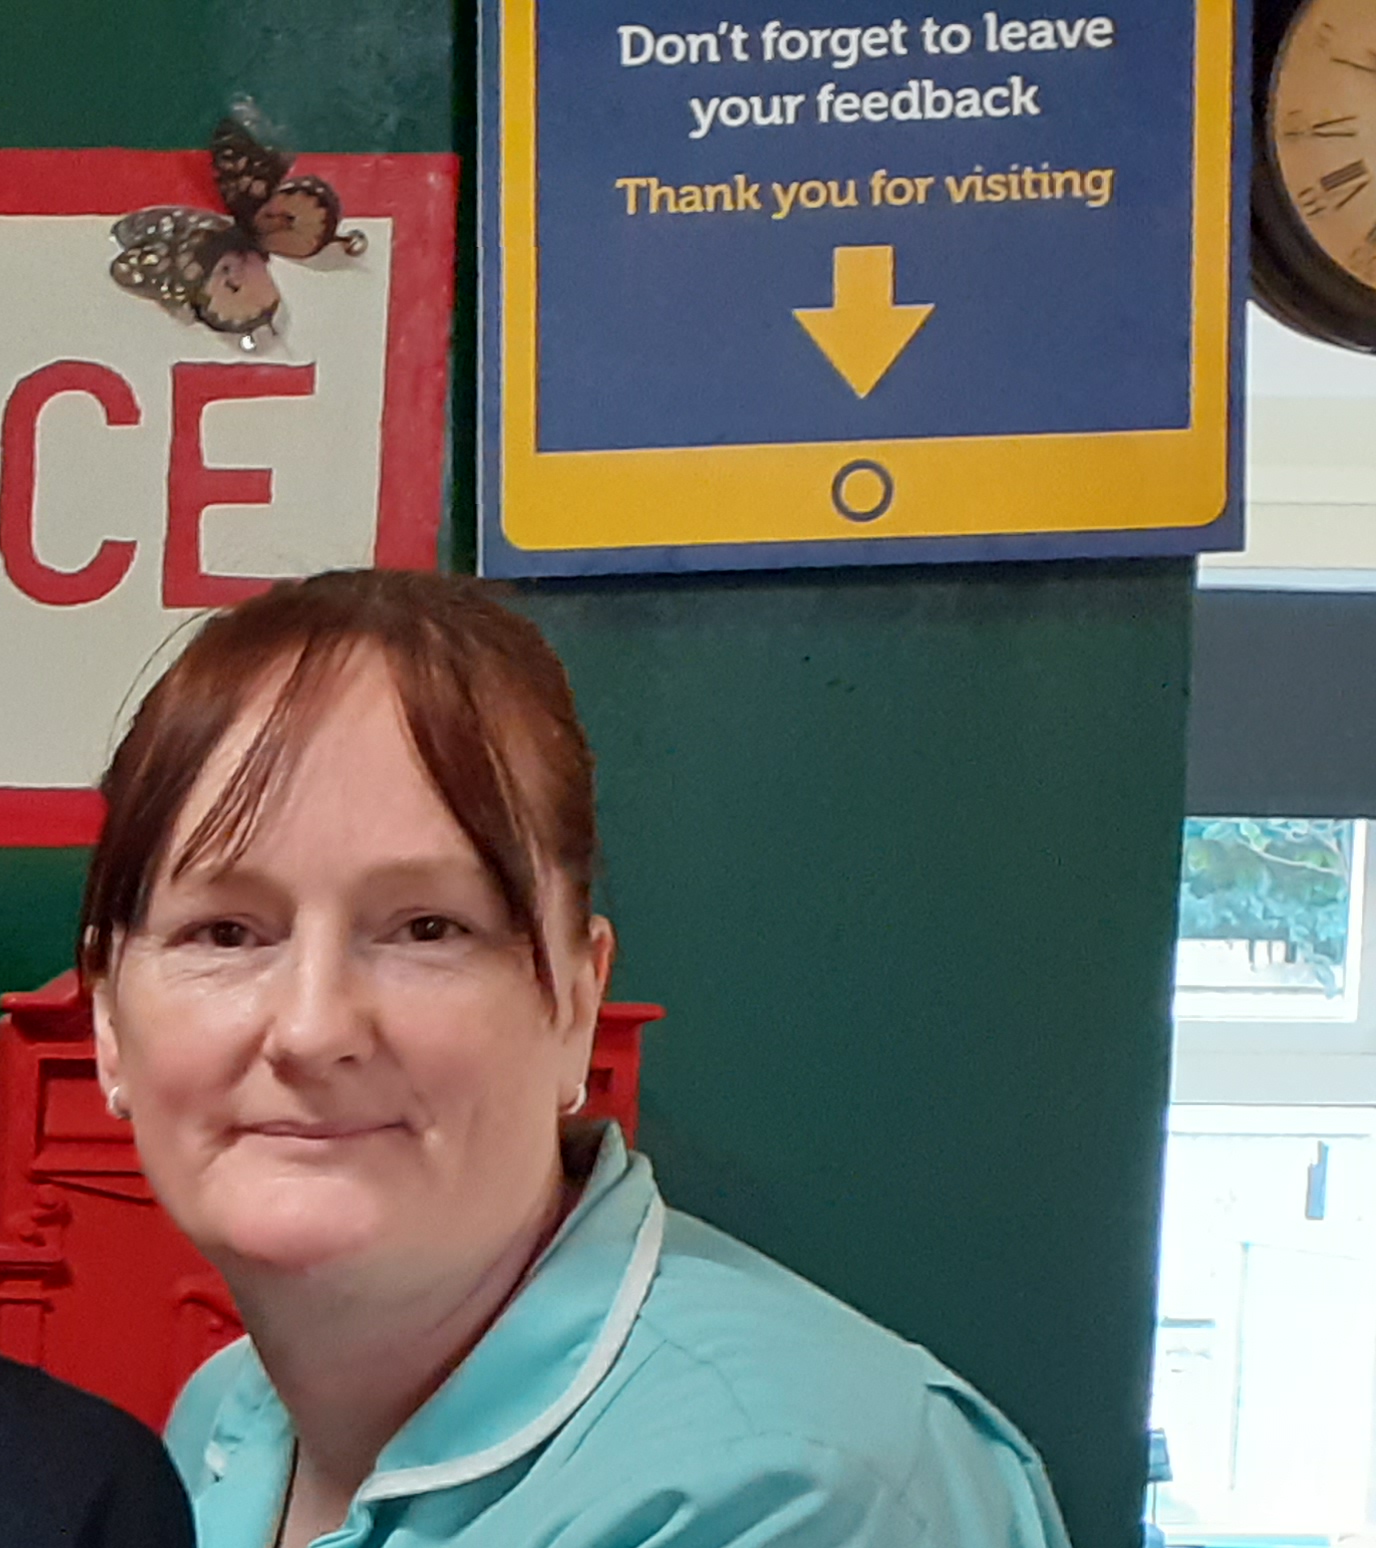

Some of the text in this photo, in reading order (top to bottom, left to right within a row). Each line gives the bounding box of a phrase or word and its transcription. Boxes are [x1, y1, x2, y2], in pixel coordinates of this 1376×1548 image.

[617, 11, 1115, 70] Don't forget to leave
[687, 76, 1041, 140] your feedback
[615, 163, 1114, 221] Thank you for visiting
